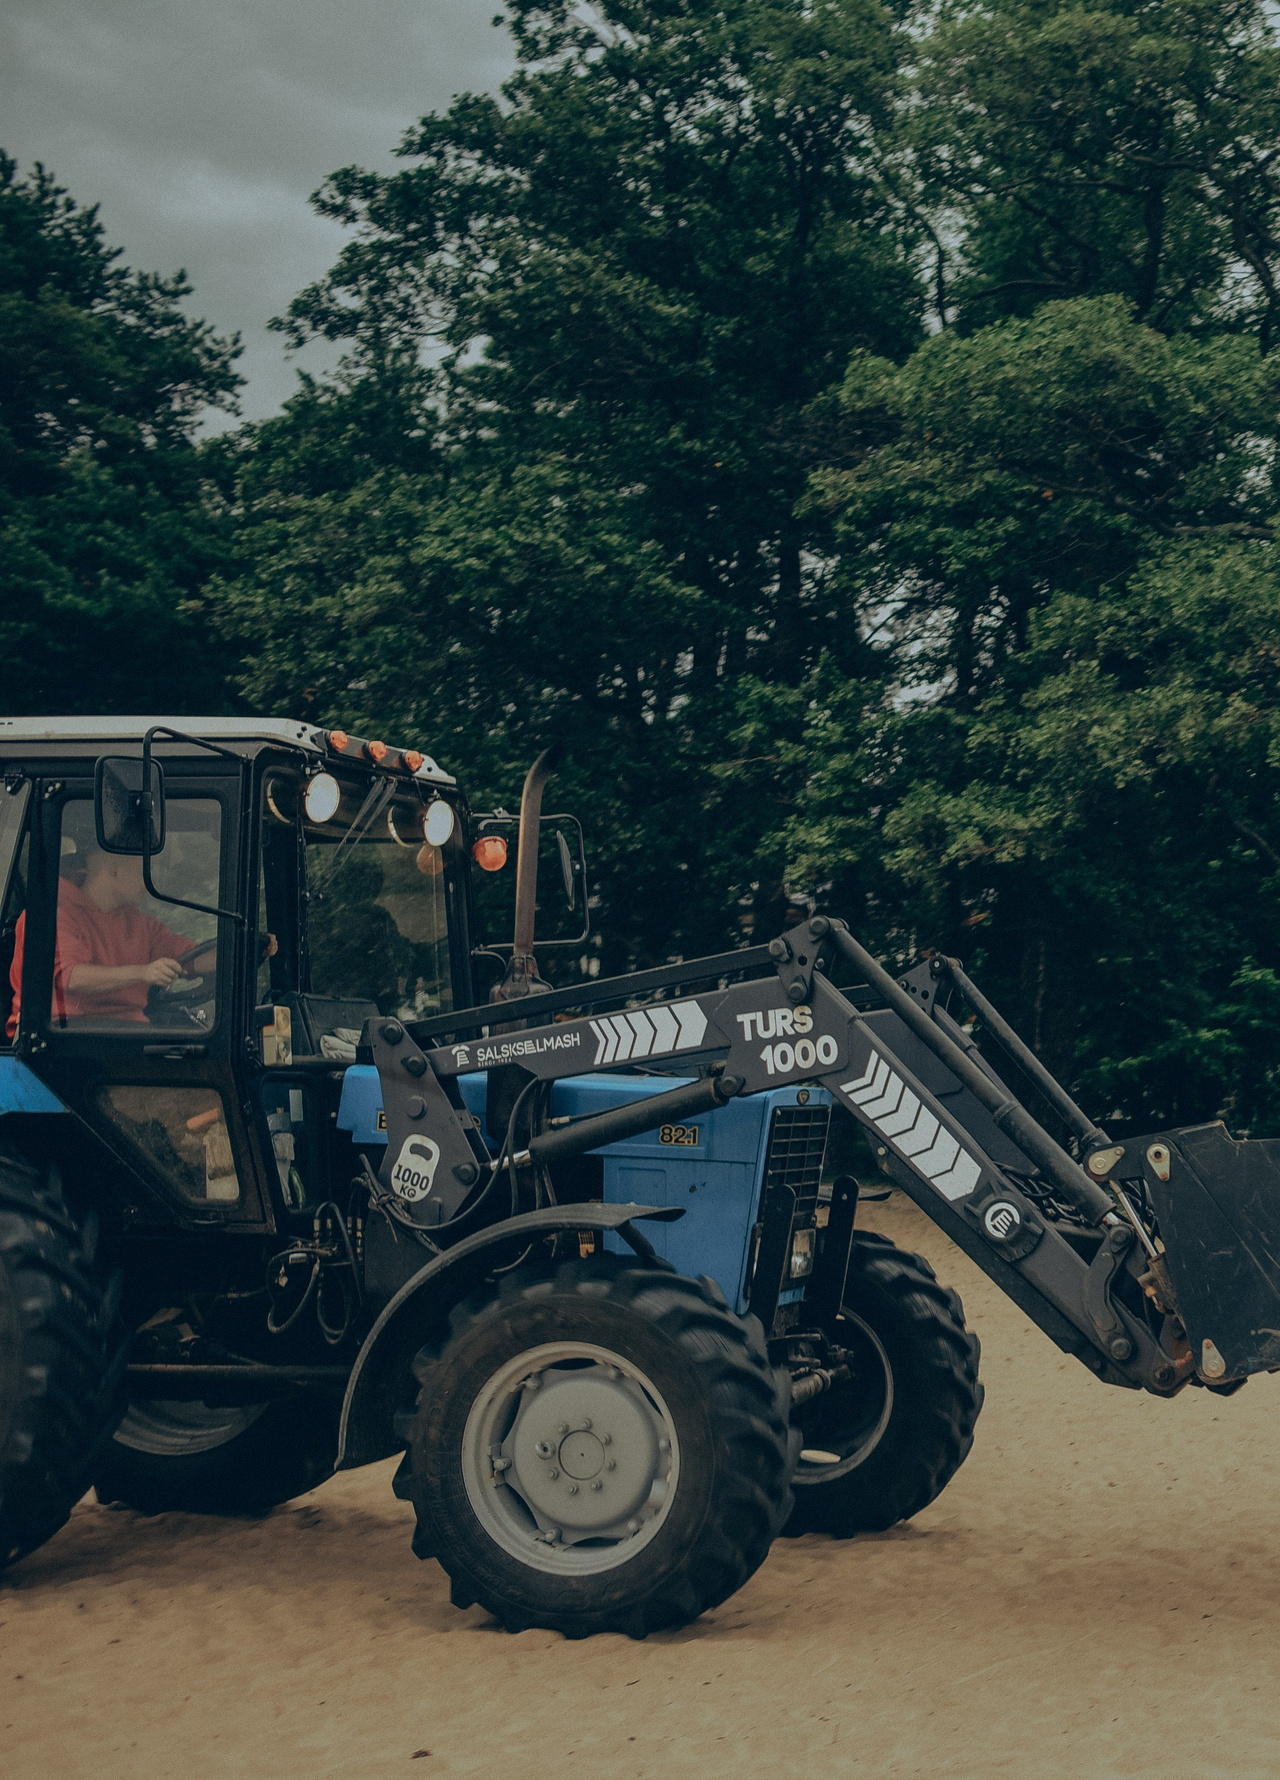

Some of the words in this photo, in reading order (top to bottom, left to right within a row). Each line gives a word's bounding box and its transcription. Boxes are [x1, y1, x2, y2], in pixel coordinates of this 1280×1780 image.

[736, 1005, 812, 1041] TURS
[476, 1032, 581, 1062] SALSKSELMASH
[760, 1035, 839, 1074] 1000
[659, 1124, 699, 1146] 82.1
[393, 1164, 430, 1191] 1000
[399, 1184, 417, 1199] KG
